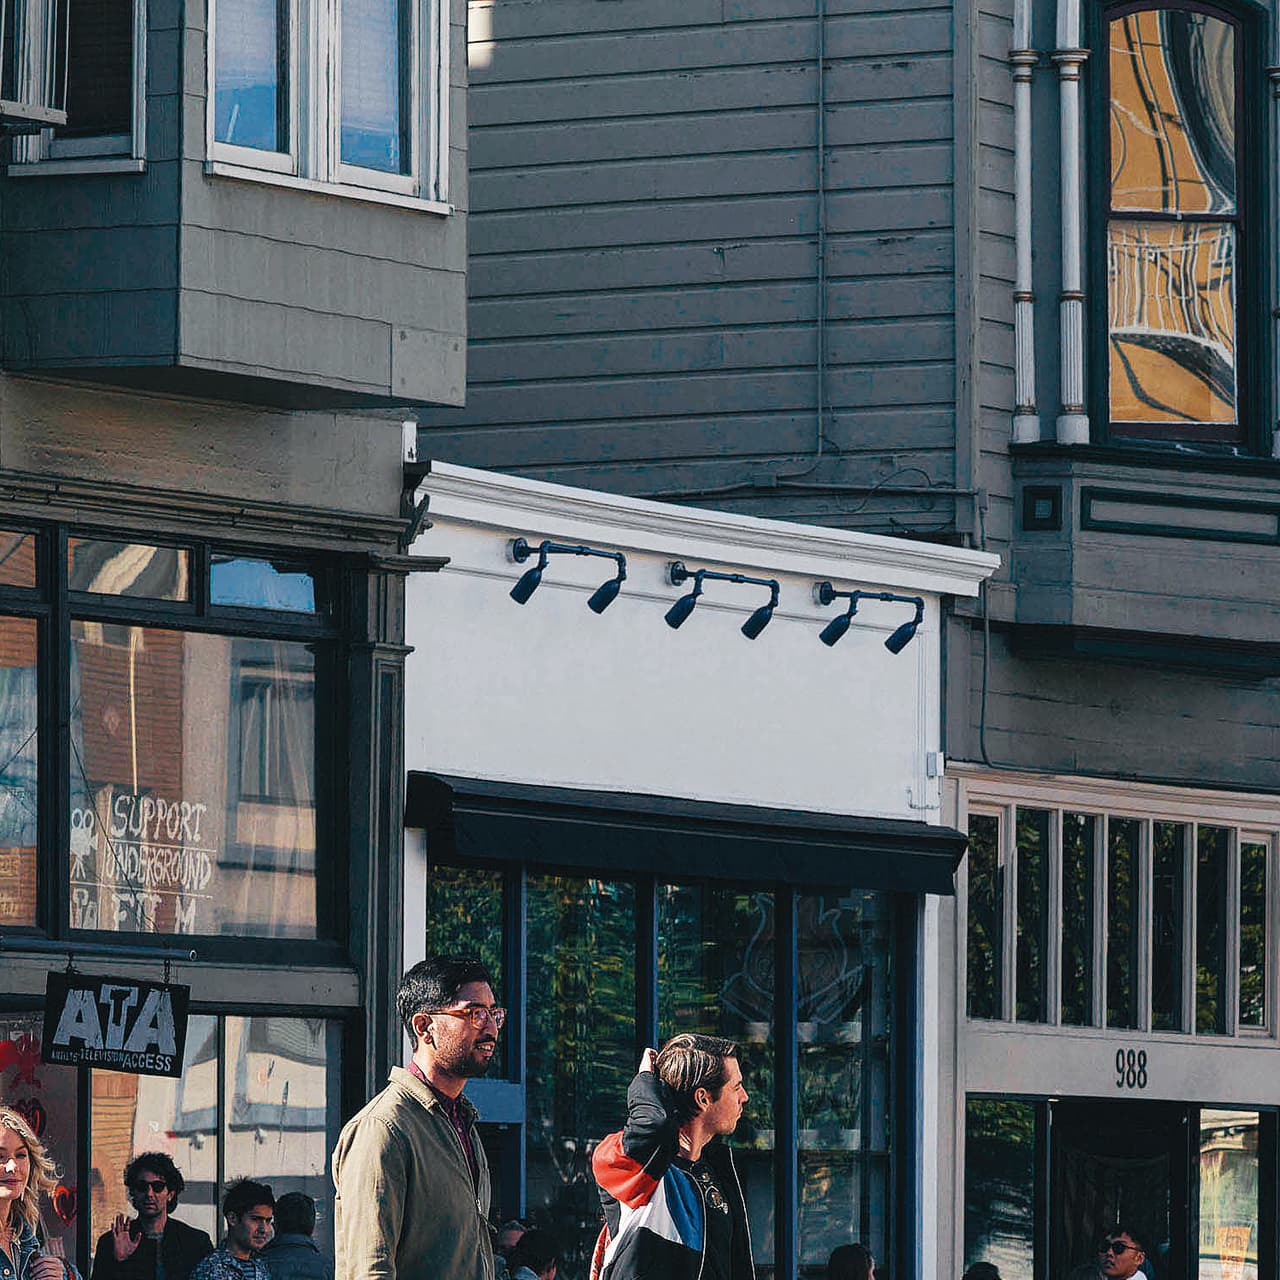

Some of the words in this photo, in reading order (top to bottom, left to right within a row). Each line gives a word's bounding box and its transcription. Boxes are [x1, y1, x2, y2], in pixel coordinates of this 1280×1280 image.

[111, 795, 208, 843] SUPPORT
[105, 845, 212, 890] UNDERGROUND
[52, 984, 177, 1056] ATA
[123, 1054, 172, 1072] ACCESS
[1116, 1048, 1147, 1089] 988
